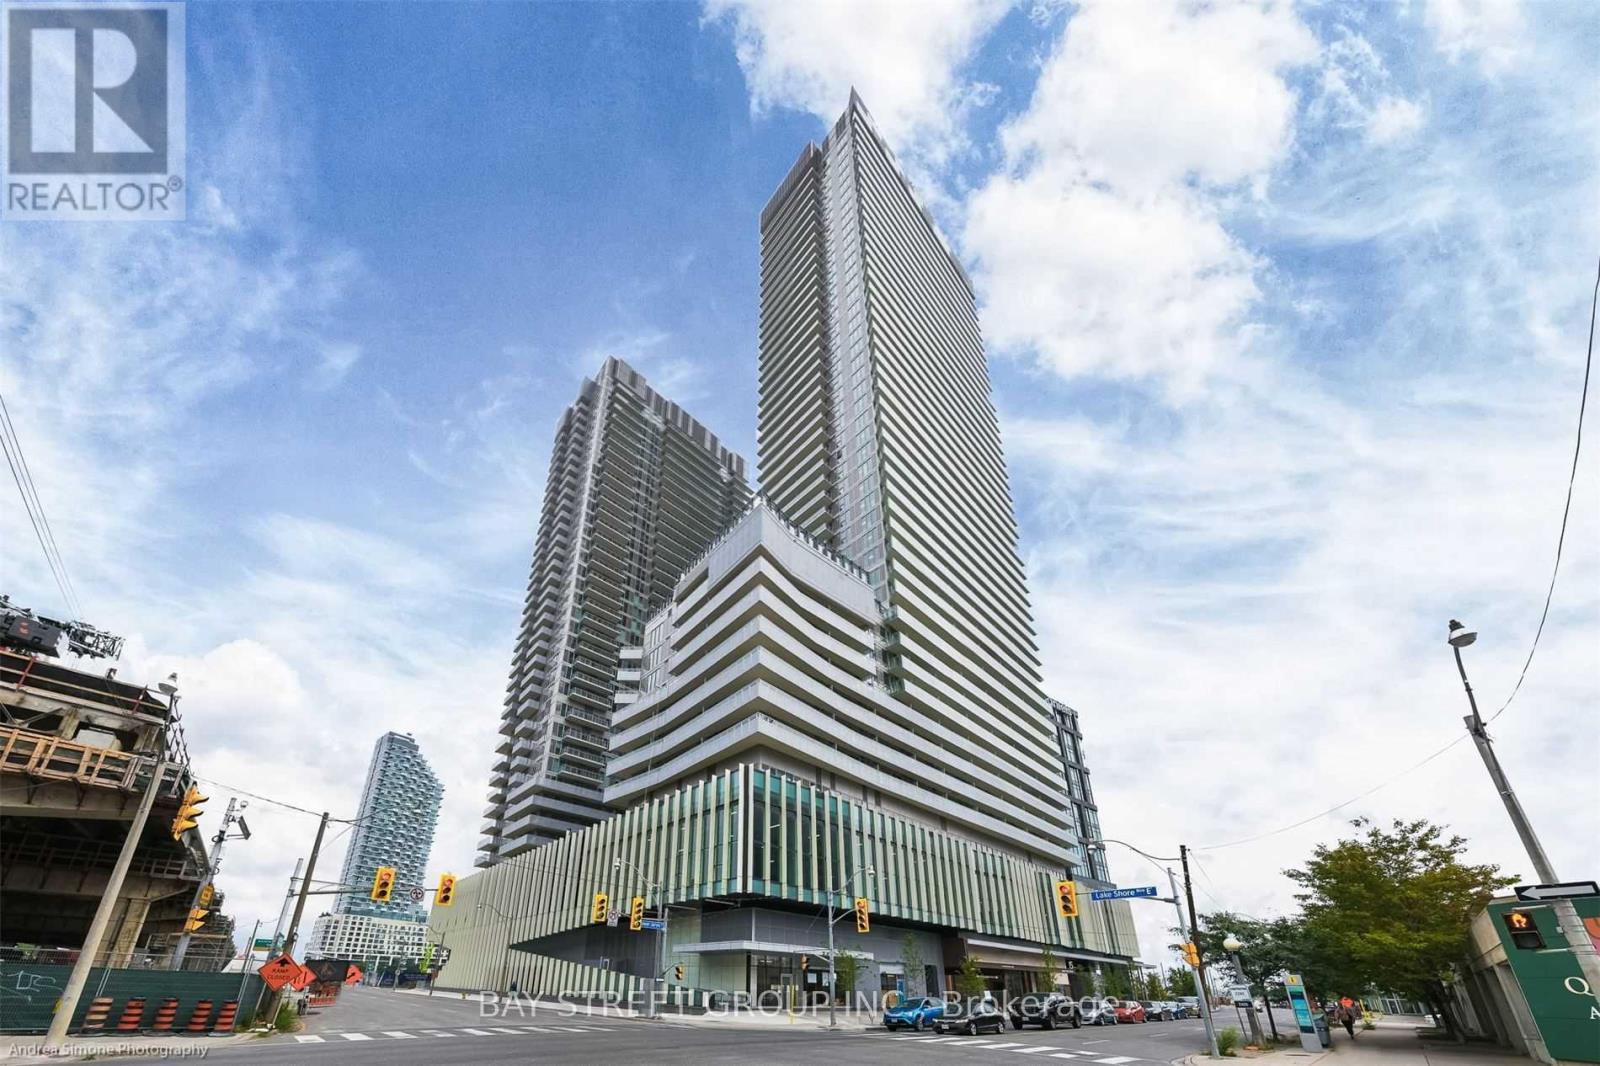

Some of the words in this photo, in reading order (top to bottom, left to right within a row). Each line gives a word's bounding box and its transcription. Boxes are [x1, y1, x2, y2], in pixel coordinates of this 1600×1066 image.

[1095, 891, 1112, 899] Lake
[1113, 889, 1135, 897] Shore
[1146, 887, 1152, 895] E
